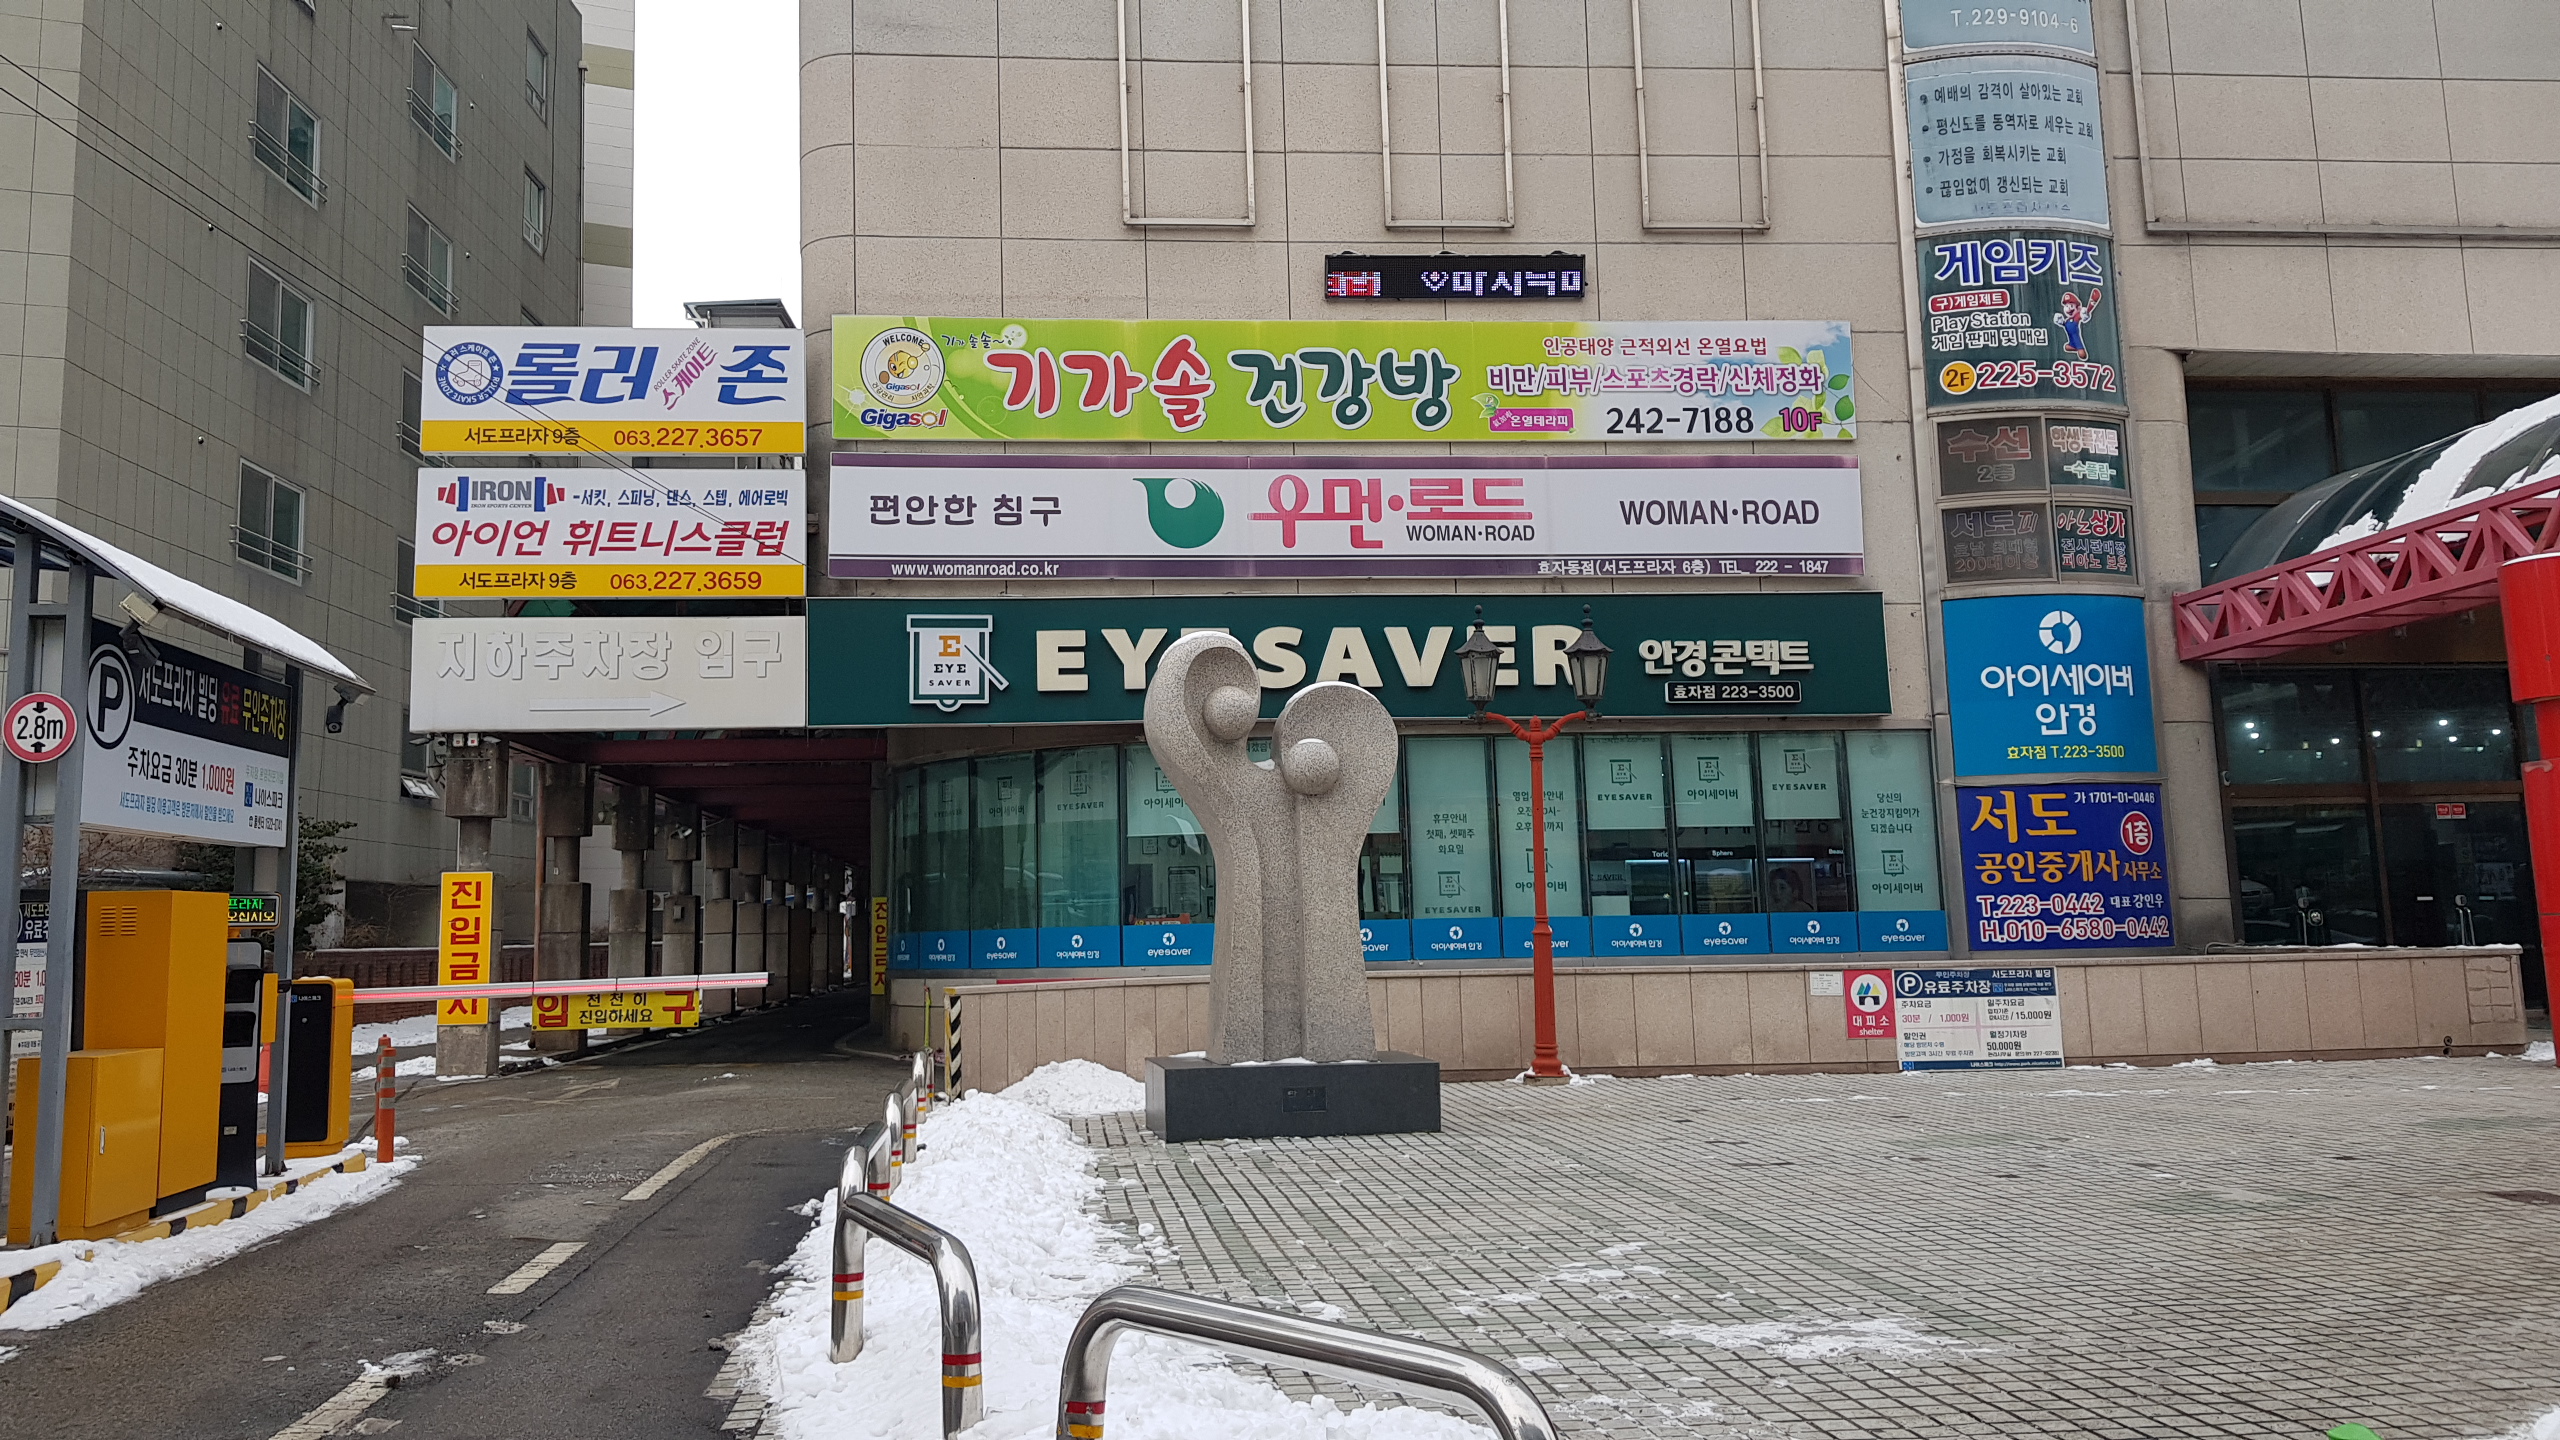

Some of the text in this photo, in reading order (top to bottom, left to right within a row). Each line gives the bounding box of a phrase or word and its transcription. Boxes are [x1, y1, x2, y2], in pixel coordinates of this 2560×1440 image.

[1951, 8, 2078, 34] T.229-9104~6
[1934, 82, 2084, 106] 예배의 감격이 살아있는 교회
[1936, 113, 2094, 140] 평신도를 동역자로 세우는 교회
[1938, 145, 2067, 167] 가정을 회복시키는 교회
[1940, 175, 2069, 198] 끊임없이 갱신되는 교회
[1934, 239, 2104, 287] 게임키즈
[1936, 293, 2004, 311] 구)게임제트
[882, 333, 925, 347] WELCOME
[1543, 337, 1767, 357] 인공태양 근적외선 온열요법
[1932, 329, 2048, 351] 게임 판매 및 매입
[505, 342, 791, 405] 롤러 존
[653, 337, 701, 392] ROLLER SKATE ZONE
[663, 342, 718, 410] 스케이트
[986, 335, 1460, 431] 기가솔 건강방
[1946, 369, 1970, 388] 2F
[1977, 360, 2117, 393] 225-3572
[886, 383, 920, 391] Gigasol
[861, 408, 948, 431] Gigasol
[1511, 415, 1568, 427] 온열테라피
[1606, 407, 1822, 434] 242-7188 10F
[464, 427, 580, 446] 서도프라자 9층
[614, 427, 763, 447] 063.227.3657
[1947, 426, 2031, 462] 수선
[2050, 426, 2118, 456] 학생복전문
[472, 480, 532, 502] IRON
[618, 489, 660, 507] 스피닝,
[703, 489, 732, 507] 스텝,
[738, 489, 789, 507] 에어로빅
[869, 494, 1062, 527] 편안한 침구
[432, 519, 790, 557] 아이언 휘트니스클럽
[2061, 538, 2126, 555] 전시판매장
[891, 561, 1059, 577] www.womanroad.co.kr
[1682, 559, 1829, 575] 6층) 222 1847
[2062, 553, 2128, 572] 피아노 보유
[459, 571, 577, 590] 서도프라자 9층
[609, 571, 762, 591] 063.227.3659
[437, 630, 782, 681] 지하주차장 입구
[939, 635, 961, 657] E
[934, 664, 966, 673] EYE
[1036, 626, 1586, 692] EYSAVER
[1981, 663, 2134, 697] 아이세이버
[1674, 685, 1795, 699] 효자점 223-3500
[198, 673, 218, 722] 빌딩
[242, 688, 286, 740] 무인주차장
[17, 715, 63, 740] 2.8m
[2035, 703, 2097, 736] 안경
[2007, 745, 2125, 760] 효자점 T.223-3500
[127, 747, 235, 795] 주차요금 30분 1,000원
[1687, 788, 1738, 800] 아이세이버
[1772, 783, 1827, 791] EYESAVER
[1876, 792, 1902, 803] 당신의
[2074, 792, 2155, 804] 가 1701-01-0446
[1433, 813, 1467, 824] 휴무안내
[1971, 790, 2077, 844] 서도
[1870, 824, 1912, 834] 되겠습니다
[2125, 821, 2149, 846] 1층
[1438, 844, 1464, 855] 화요일
[1975, 849, 2162, 885] 공인중개사 사무소
[1872, 883, 1923, 894] 아이세이버
[1425, 906, 1481, 914] EYESAVER
[1976, 893, 2105, 918] T.223-0442
[2110, 896, 2132, 908] 대표
[1882, 934, 1925, 943] eyesaver
[1980, 916, 2170, 943] H.010-6580-0442
[1703, 937, 1748, 945] eyesaver
[1148, 947, 1192, 957] eyesaver
[1992, 969, 2051, 979] 서도프라자 빌딩
[1924, 980, 1991, 994] 유료주차장
[579, 1009, 653, 1024] 진입하세요
[1902, 1014, 1920, 1023] 30분
[1860, 1028, 1884, 1036] shelter
